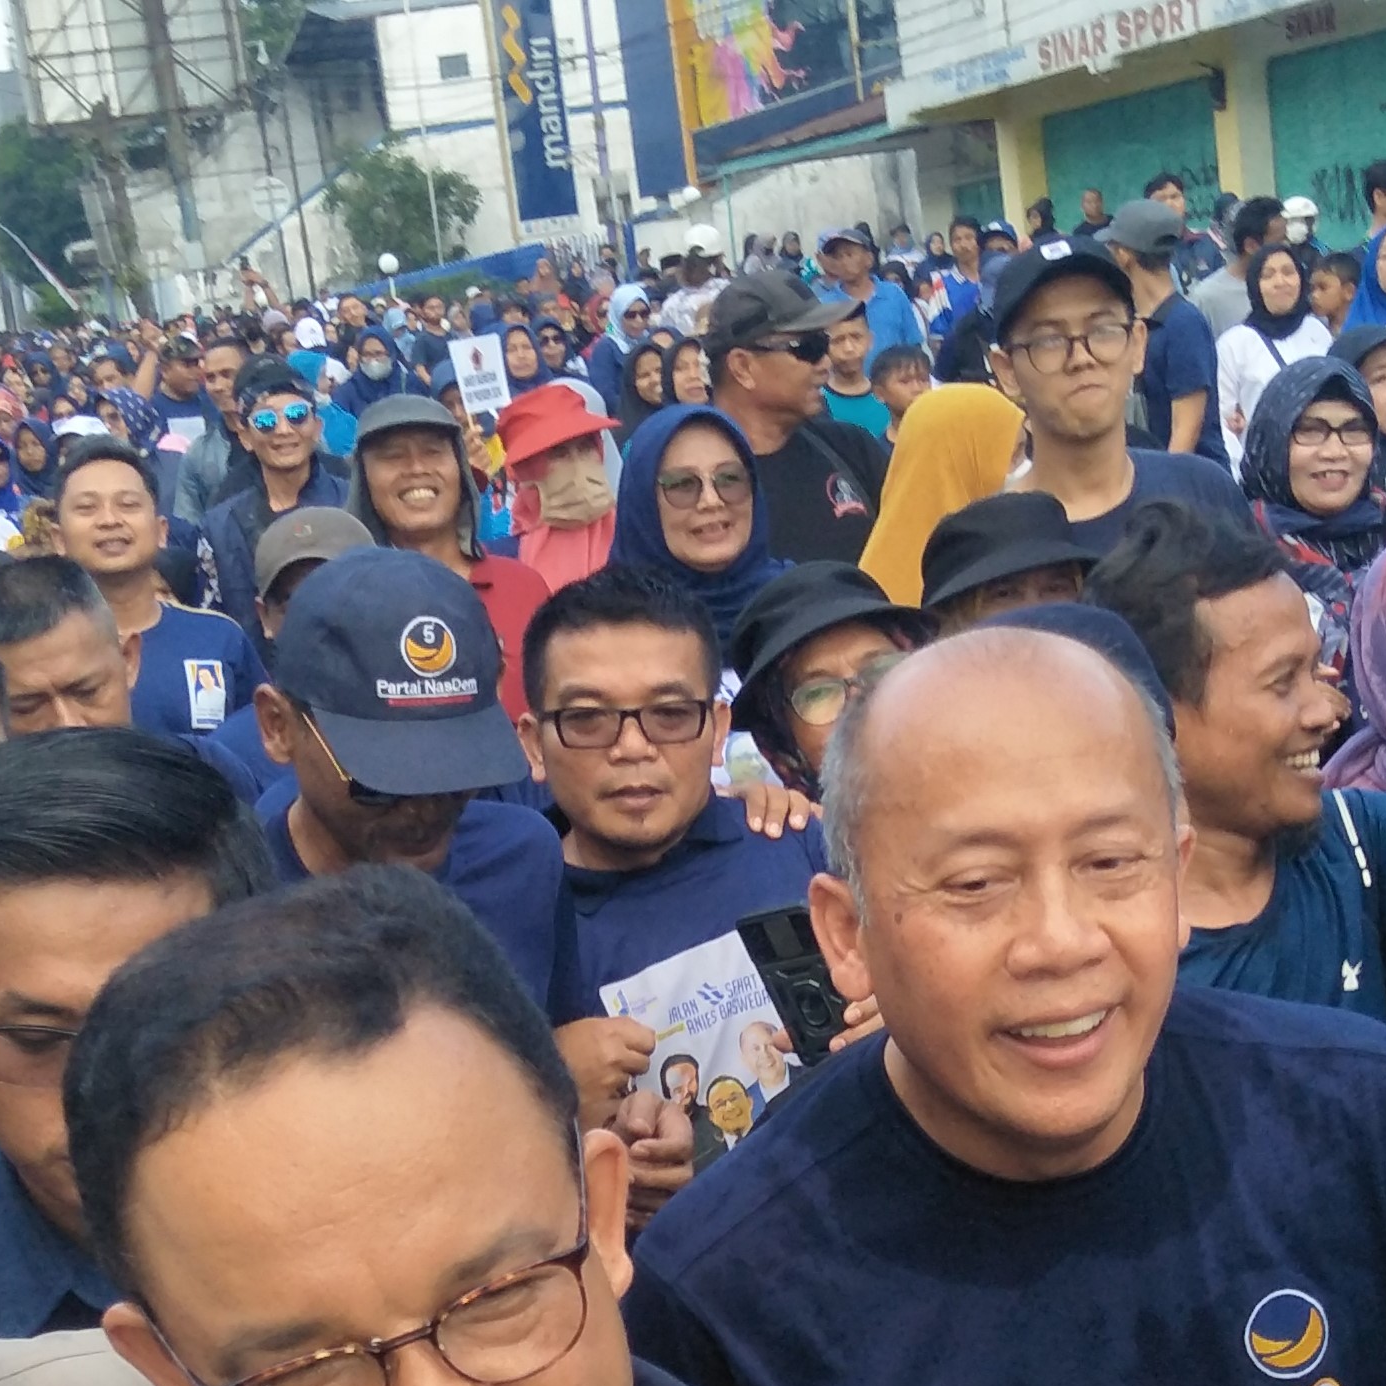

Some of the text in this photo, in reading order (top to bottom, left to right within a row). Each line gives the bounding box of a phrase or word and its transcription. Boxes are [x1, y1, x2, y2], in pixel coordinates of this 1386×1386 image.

[1038, 16, 1107, 71] SINAR
[1115, 0, 1201, 49] SPORT
[526, 36, 571, 170] mandiri
[422, 622, 436, 644] 5
[376, 677, 478, 697] Partai NasDem
[668, 999, 700, 1025] JALAN
[725, 973, 758, 999] SEHAT
[686, 989, 771, 1036] ANIES BASWEDA
